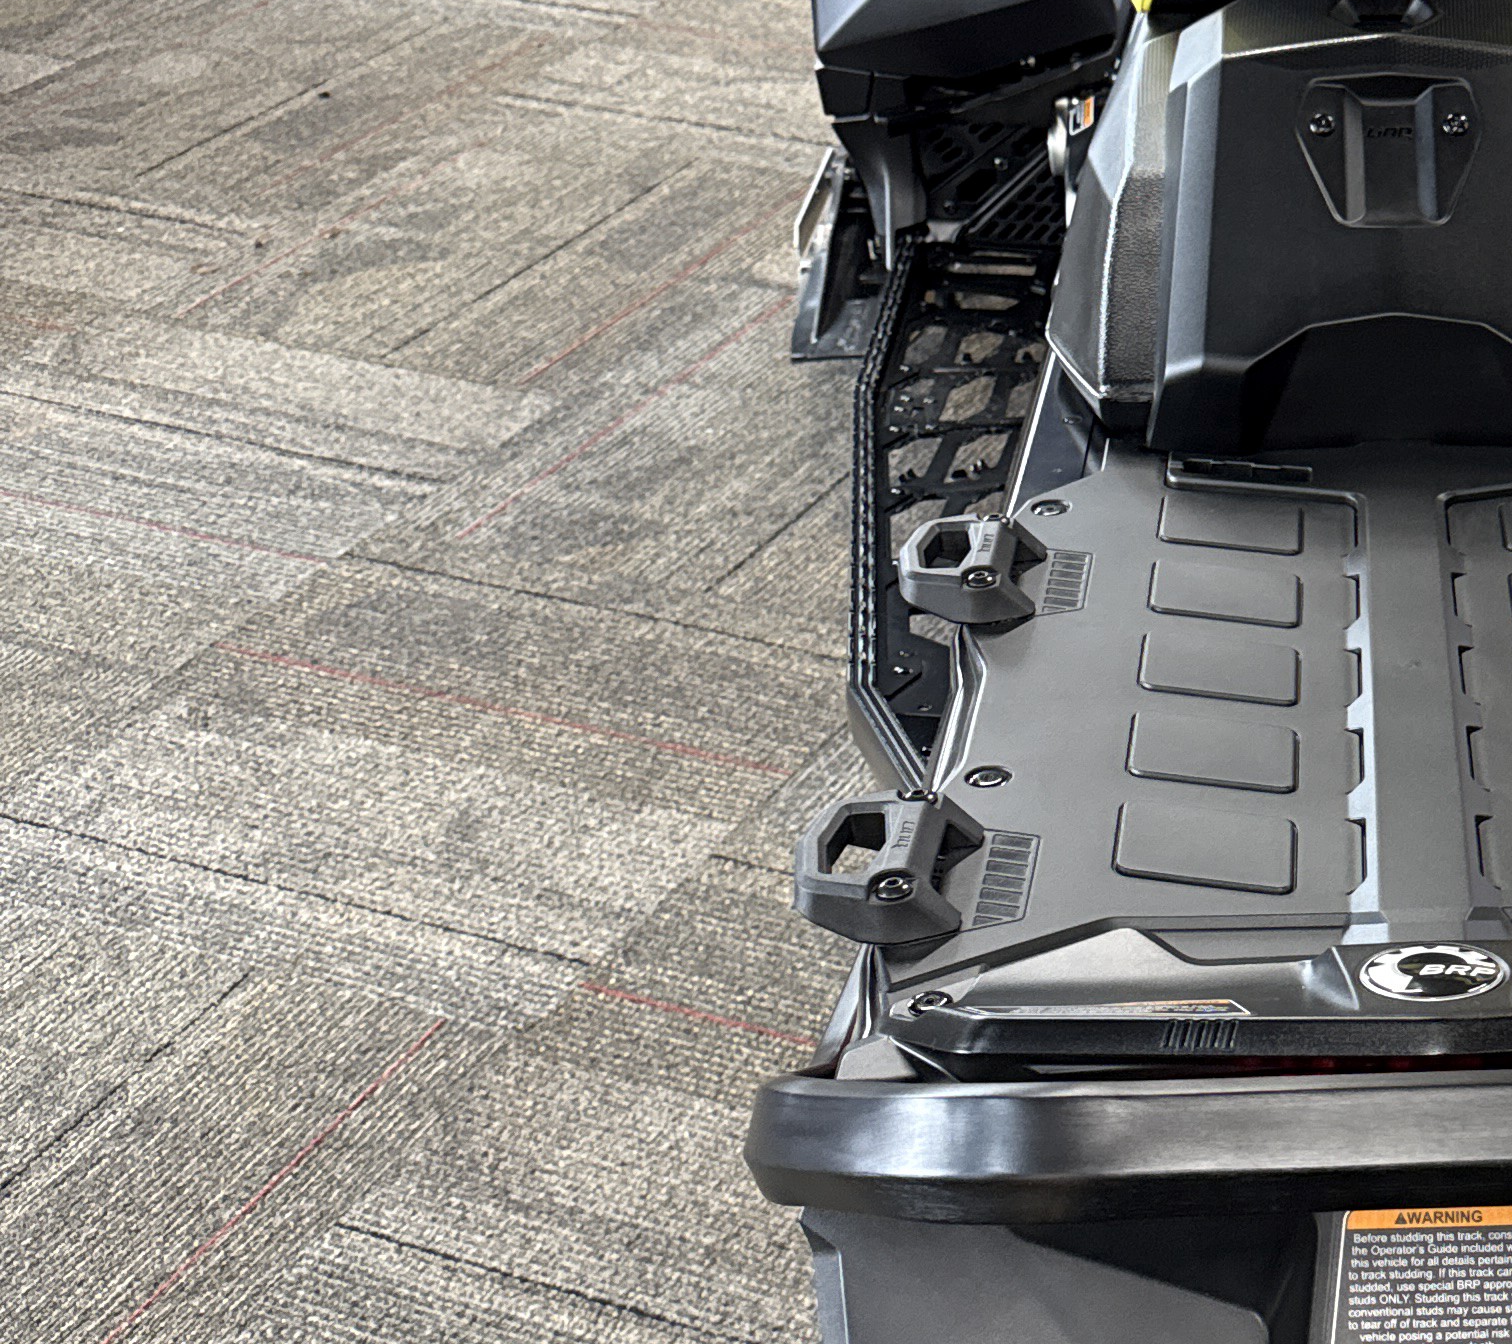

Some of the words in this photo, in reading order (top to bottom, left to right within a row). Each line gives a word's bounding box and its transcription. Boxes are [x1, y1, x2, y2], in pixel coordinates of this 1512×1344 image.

[1419, 964, 1497, 977] BRP
[1407, 1210, 1483, 1224] WARNING
[1353, 1233, 1387, 1244] Before
[1390, 1232, 1434, 1244] studding
[1437, 1231, 1455, 1242] this
[1351, 1245, 1368, 1256] the
[1427, 1243, 1459, 1254] Guide
[1461, 1242, 1504, 1253] included
[1350, 1258, 1370, 1268] this
[1372, 1257, 1408, 1267] vehicle
[1410, 1256, 1425, 1266] for
[1427, 1256, 1440, 1266] all
[1441, 1255, 1475, 1266] details
[1348, 1271, 1358, 1281] to
[1361, 1270, 1387, 1280] track
[1438, 1268, 1447, 1278] If
[1448, 1268, 1467, 1278] this
[1469, 1267, 1495, 1277] track
[1349, 1282, 1394, 1293] studded,
[1396, 1283, 1415, 1292] use
[1418, 1281, 1454, 1293] special
[1456, 1279, 1481, 1290] BRP
[1348, 1295, 1376, 1305] studs
[1414, 1292, 1460, 1305] Studding
[1462, 1292, 1481, 1302] this
[1483, 1292, 1509, 1302] track
[1348, 1306, 1414, 1318] conventional
[1416, 1305, 1444, 1316] studs
[1446, 1306, 1469, 1318] may
[1471, 1306, 1503, 1315] cause
[1348, 1320, 1359, 1330] to
[1361, 1320, 1382, 1330] tear
[1384, 1318, 1398, 1329] off
[1400, 1318, 1411, 1329] of
[1412, 1318, 1438, 1329] track
[1440, 1317, 1460, 1328] and
[1462, 1317, 1508, 1329] separate
[1359, 1331, 1396, 1342] vehicle
[1398, 1331, 1433, 1343] posing
[1435, 1331, 1443, 1340] a
[1445, 1329, 1490, 1342] potential
[1491, 1328, 1510, 1338] risk
